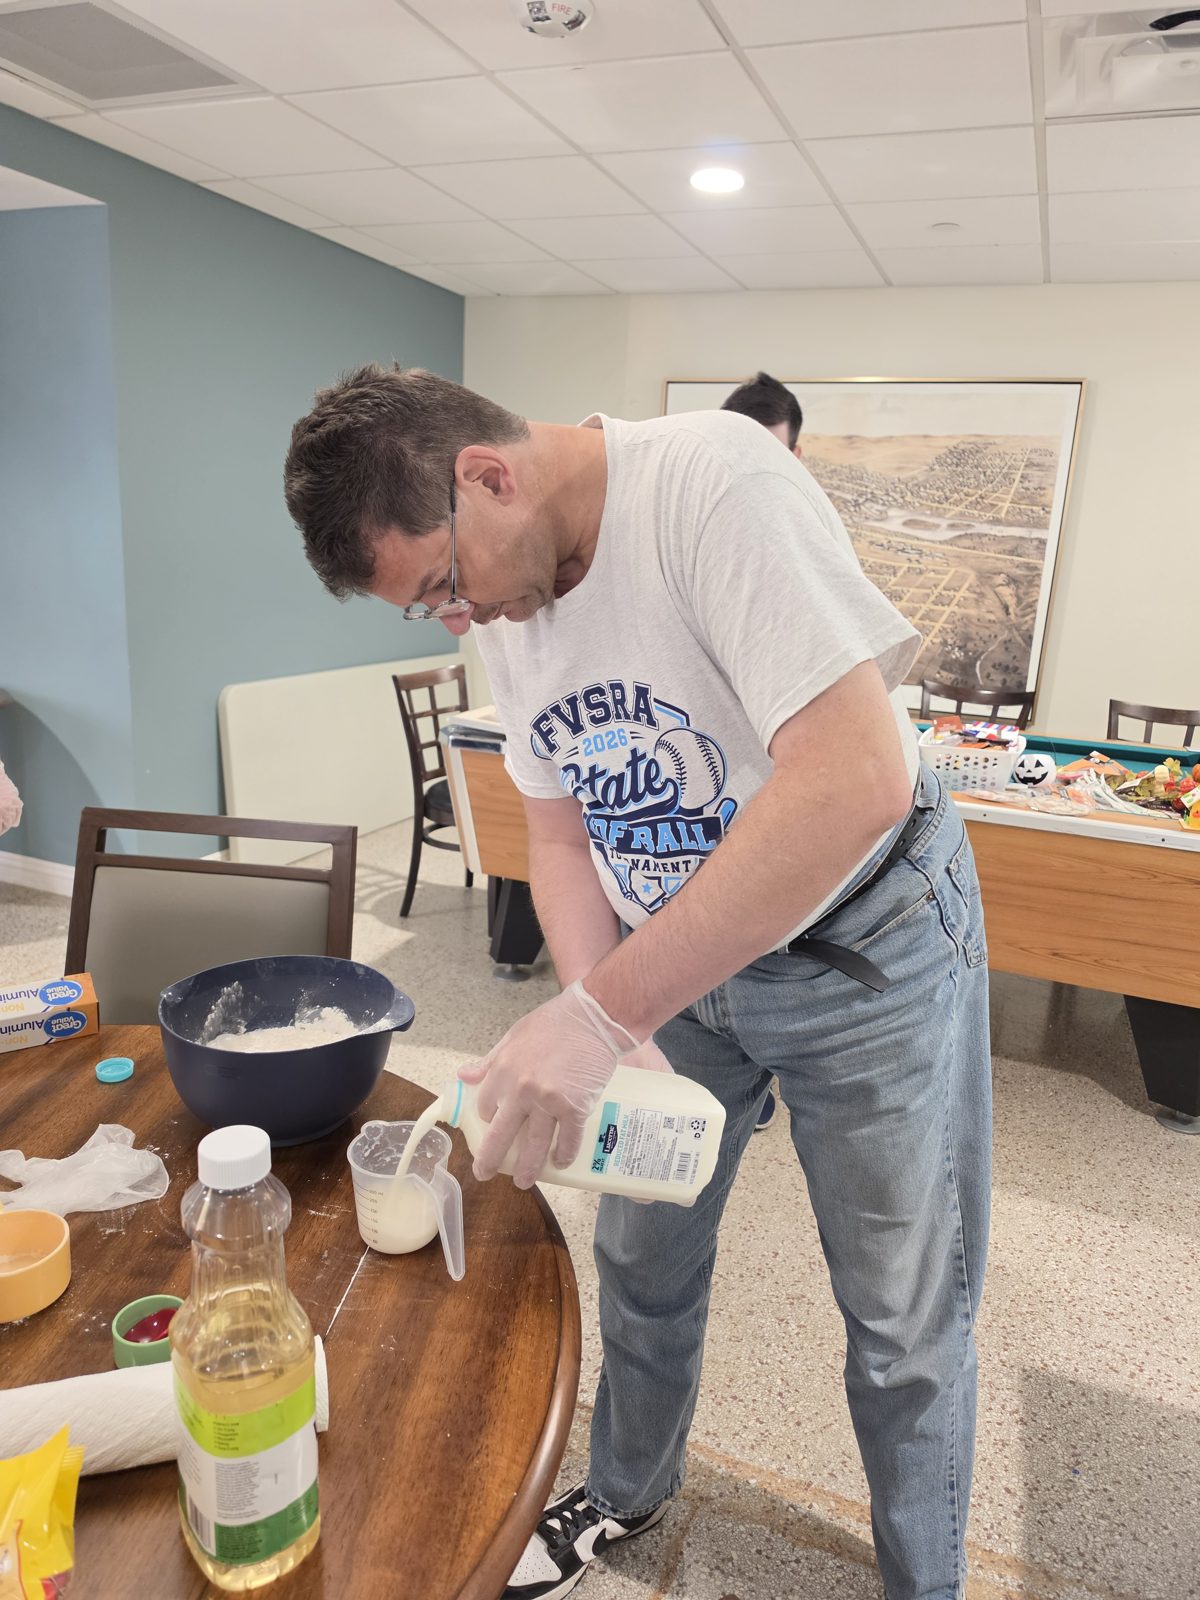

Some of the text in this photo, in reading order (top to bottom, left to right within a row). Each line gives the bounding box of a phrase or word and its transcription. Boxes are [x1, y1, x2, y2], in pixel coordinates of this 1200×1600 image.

[552, 3, 572, 15] FIRE
[530, 679, 659, 758] FVSRA
[582, 728, 628, 757] 2026
[590, 817, 717, 854] OFBALL
[609, 847, 692, 873] TNAMENT
[47, 989, 78, 1002] Great
[52, 1020, 82, 1033] Great
[604, 1125, 615, 1153] Lucerne
[591, 1158, 602, 1171] 2%
[613, 1140, 624, 1167] REDUCED
